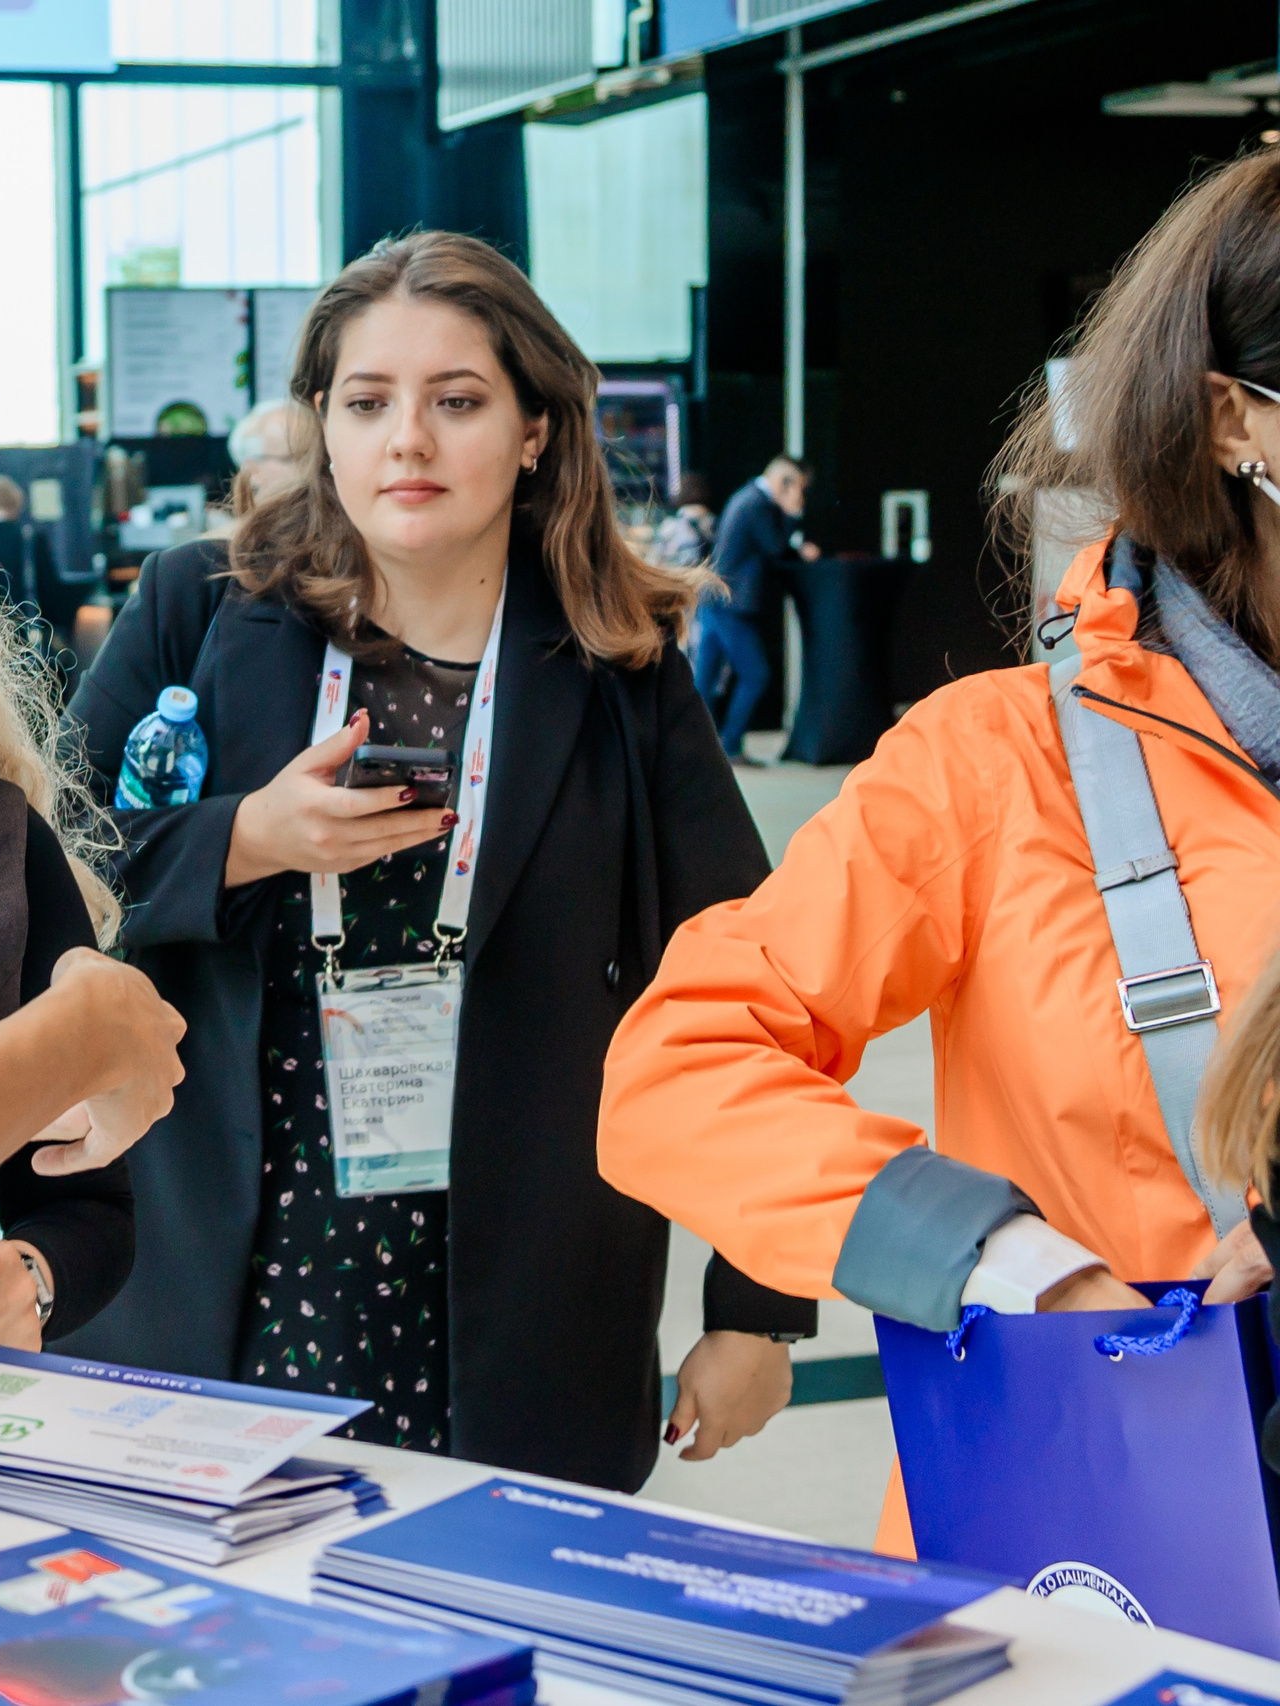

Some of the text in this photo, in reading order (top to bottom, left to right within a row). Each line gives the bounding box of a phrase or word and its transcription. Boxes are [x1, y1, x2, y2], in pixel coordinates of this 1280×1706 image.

[340, 1078, 424, 1095] Екатерина
[341, 1094, 425, 1110] Екатерина
[1045, 1574, 1056, 1591] О
[1056, 1569, 1127, 1610] ПАЦИЕНТАХ
